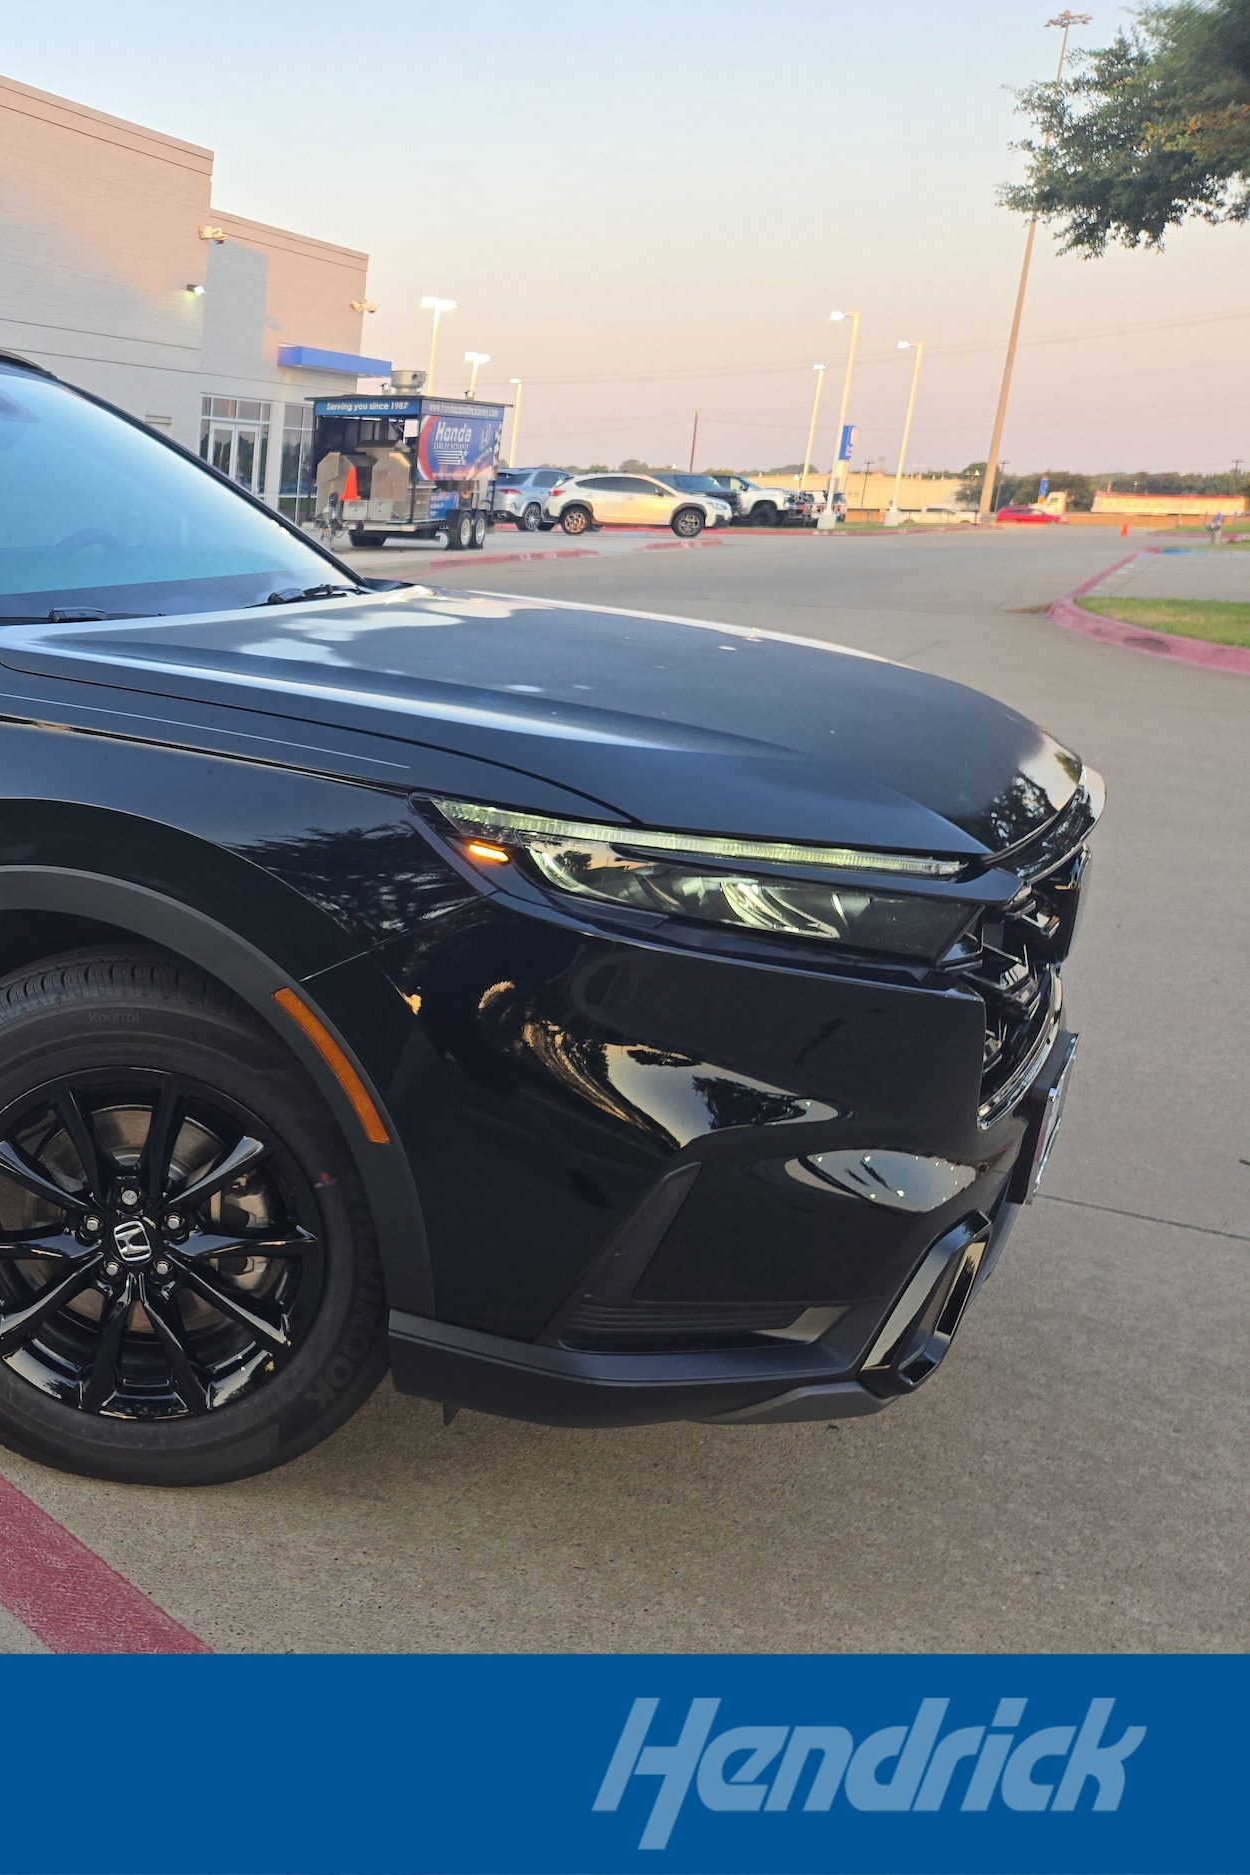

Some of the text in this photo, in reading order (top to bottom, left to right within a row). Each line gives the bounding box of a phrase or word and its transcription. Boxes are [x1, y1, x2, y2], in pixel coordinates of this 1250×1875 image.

[326, 401, 410, 413] Serving you since 1987
[435, 420, 472, 443] Honda
[88, 1011, 140, 1024] Kontrol
